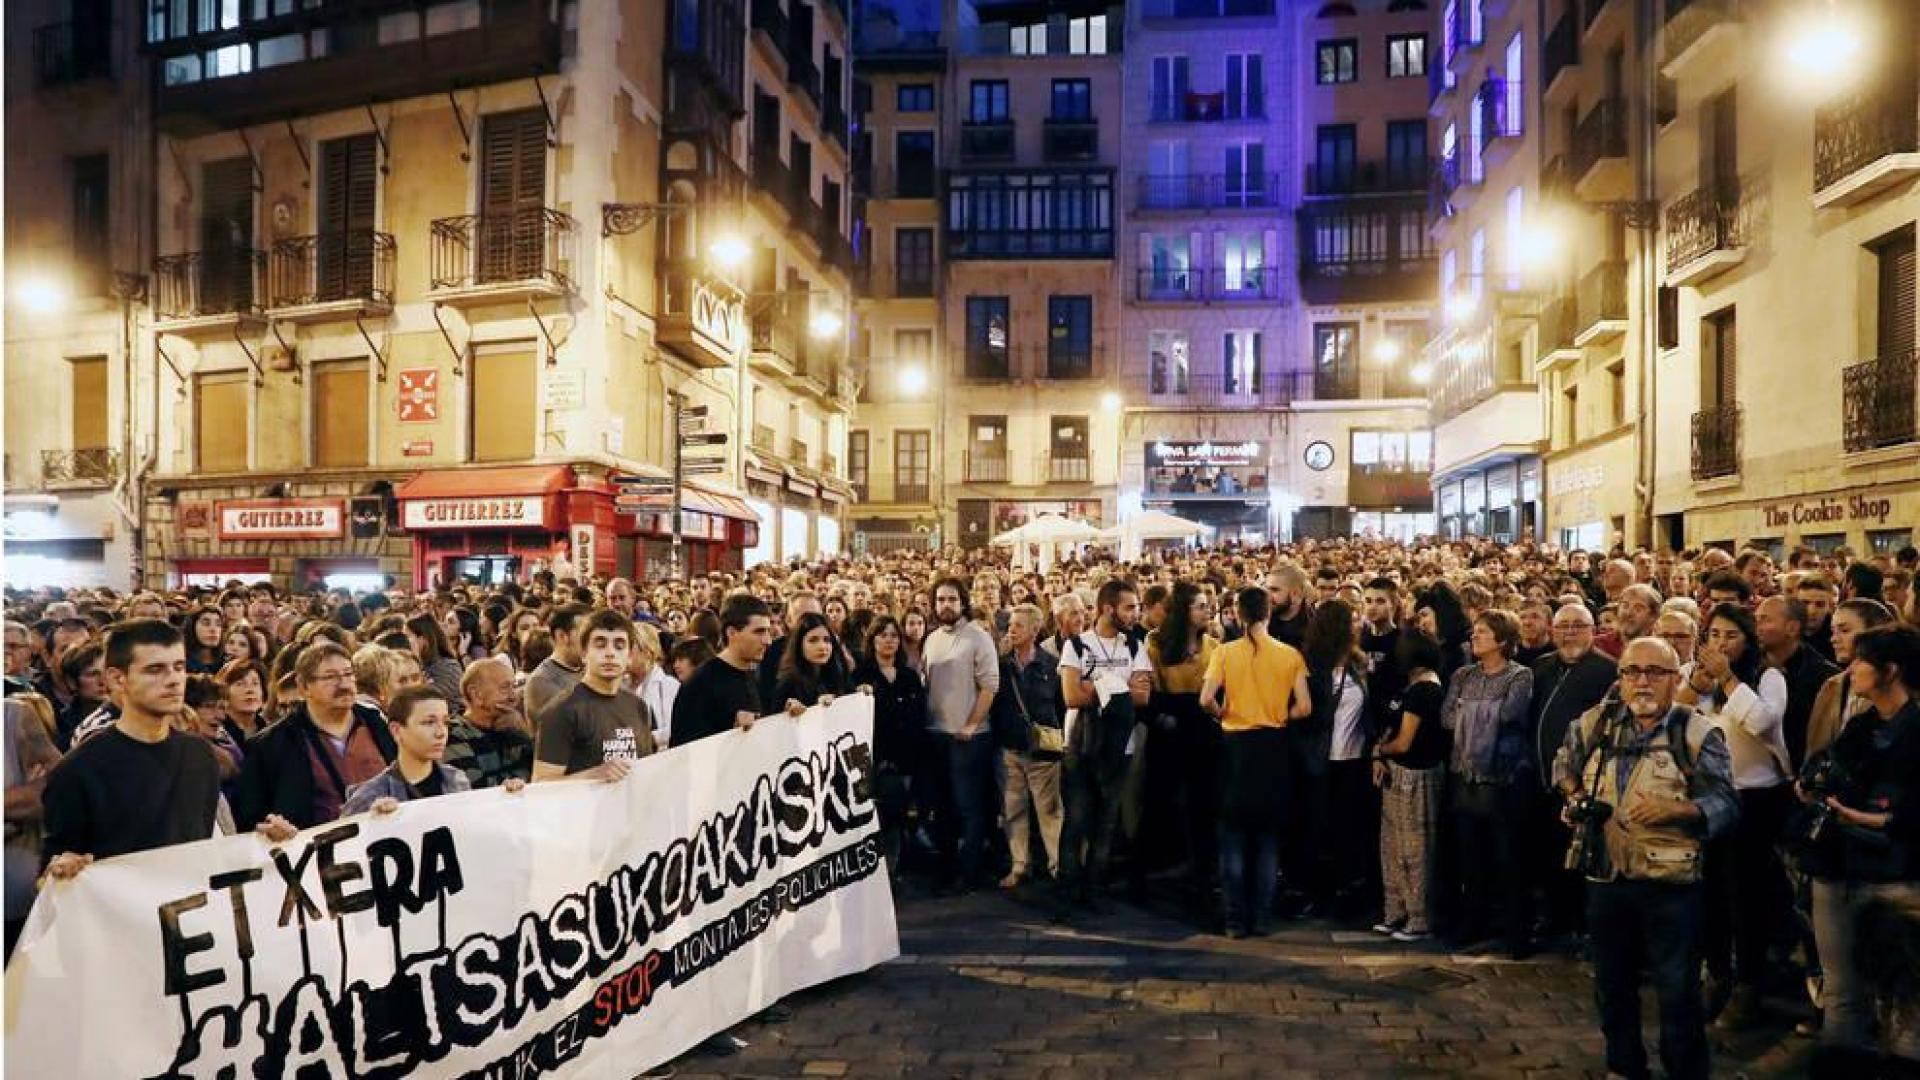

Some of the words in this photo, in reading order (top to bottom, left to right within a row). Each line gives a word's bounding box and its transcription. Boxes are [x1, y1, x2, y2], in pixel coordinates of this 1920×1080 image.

[238, 510, 325, 528] GUTIERREZ
[424, 496, 525, 521] GUTIERREZ
[1763, 503, 1789, 527] The
[1792, 498, 1843, 525] Cookie
[1848, 493, 1890, 524] Shop
[159, 823, 463, 995] ETXERA
[555, 1013, 583, 1060] EZ
[593, 951, 661, 1026] STOP
[673, 895, 770, 978] MONTAJES
[775, 839, 878, 911] POLICIALES
